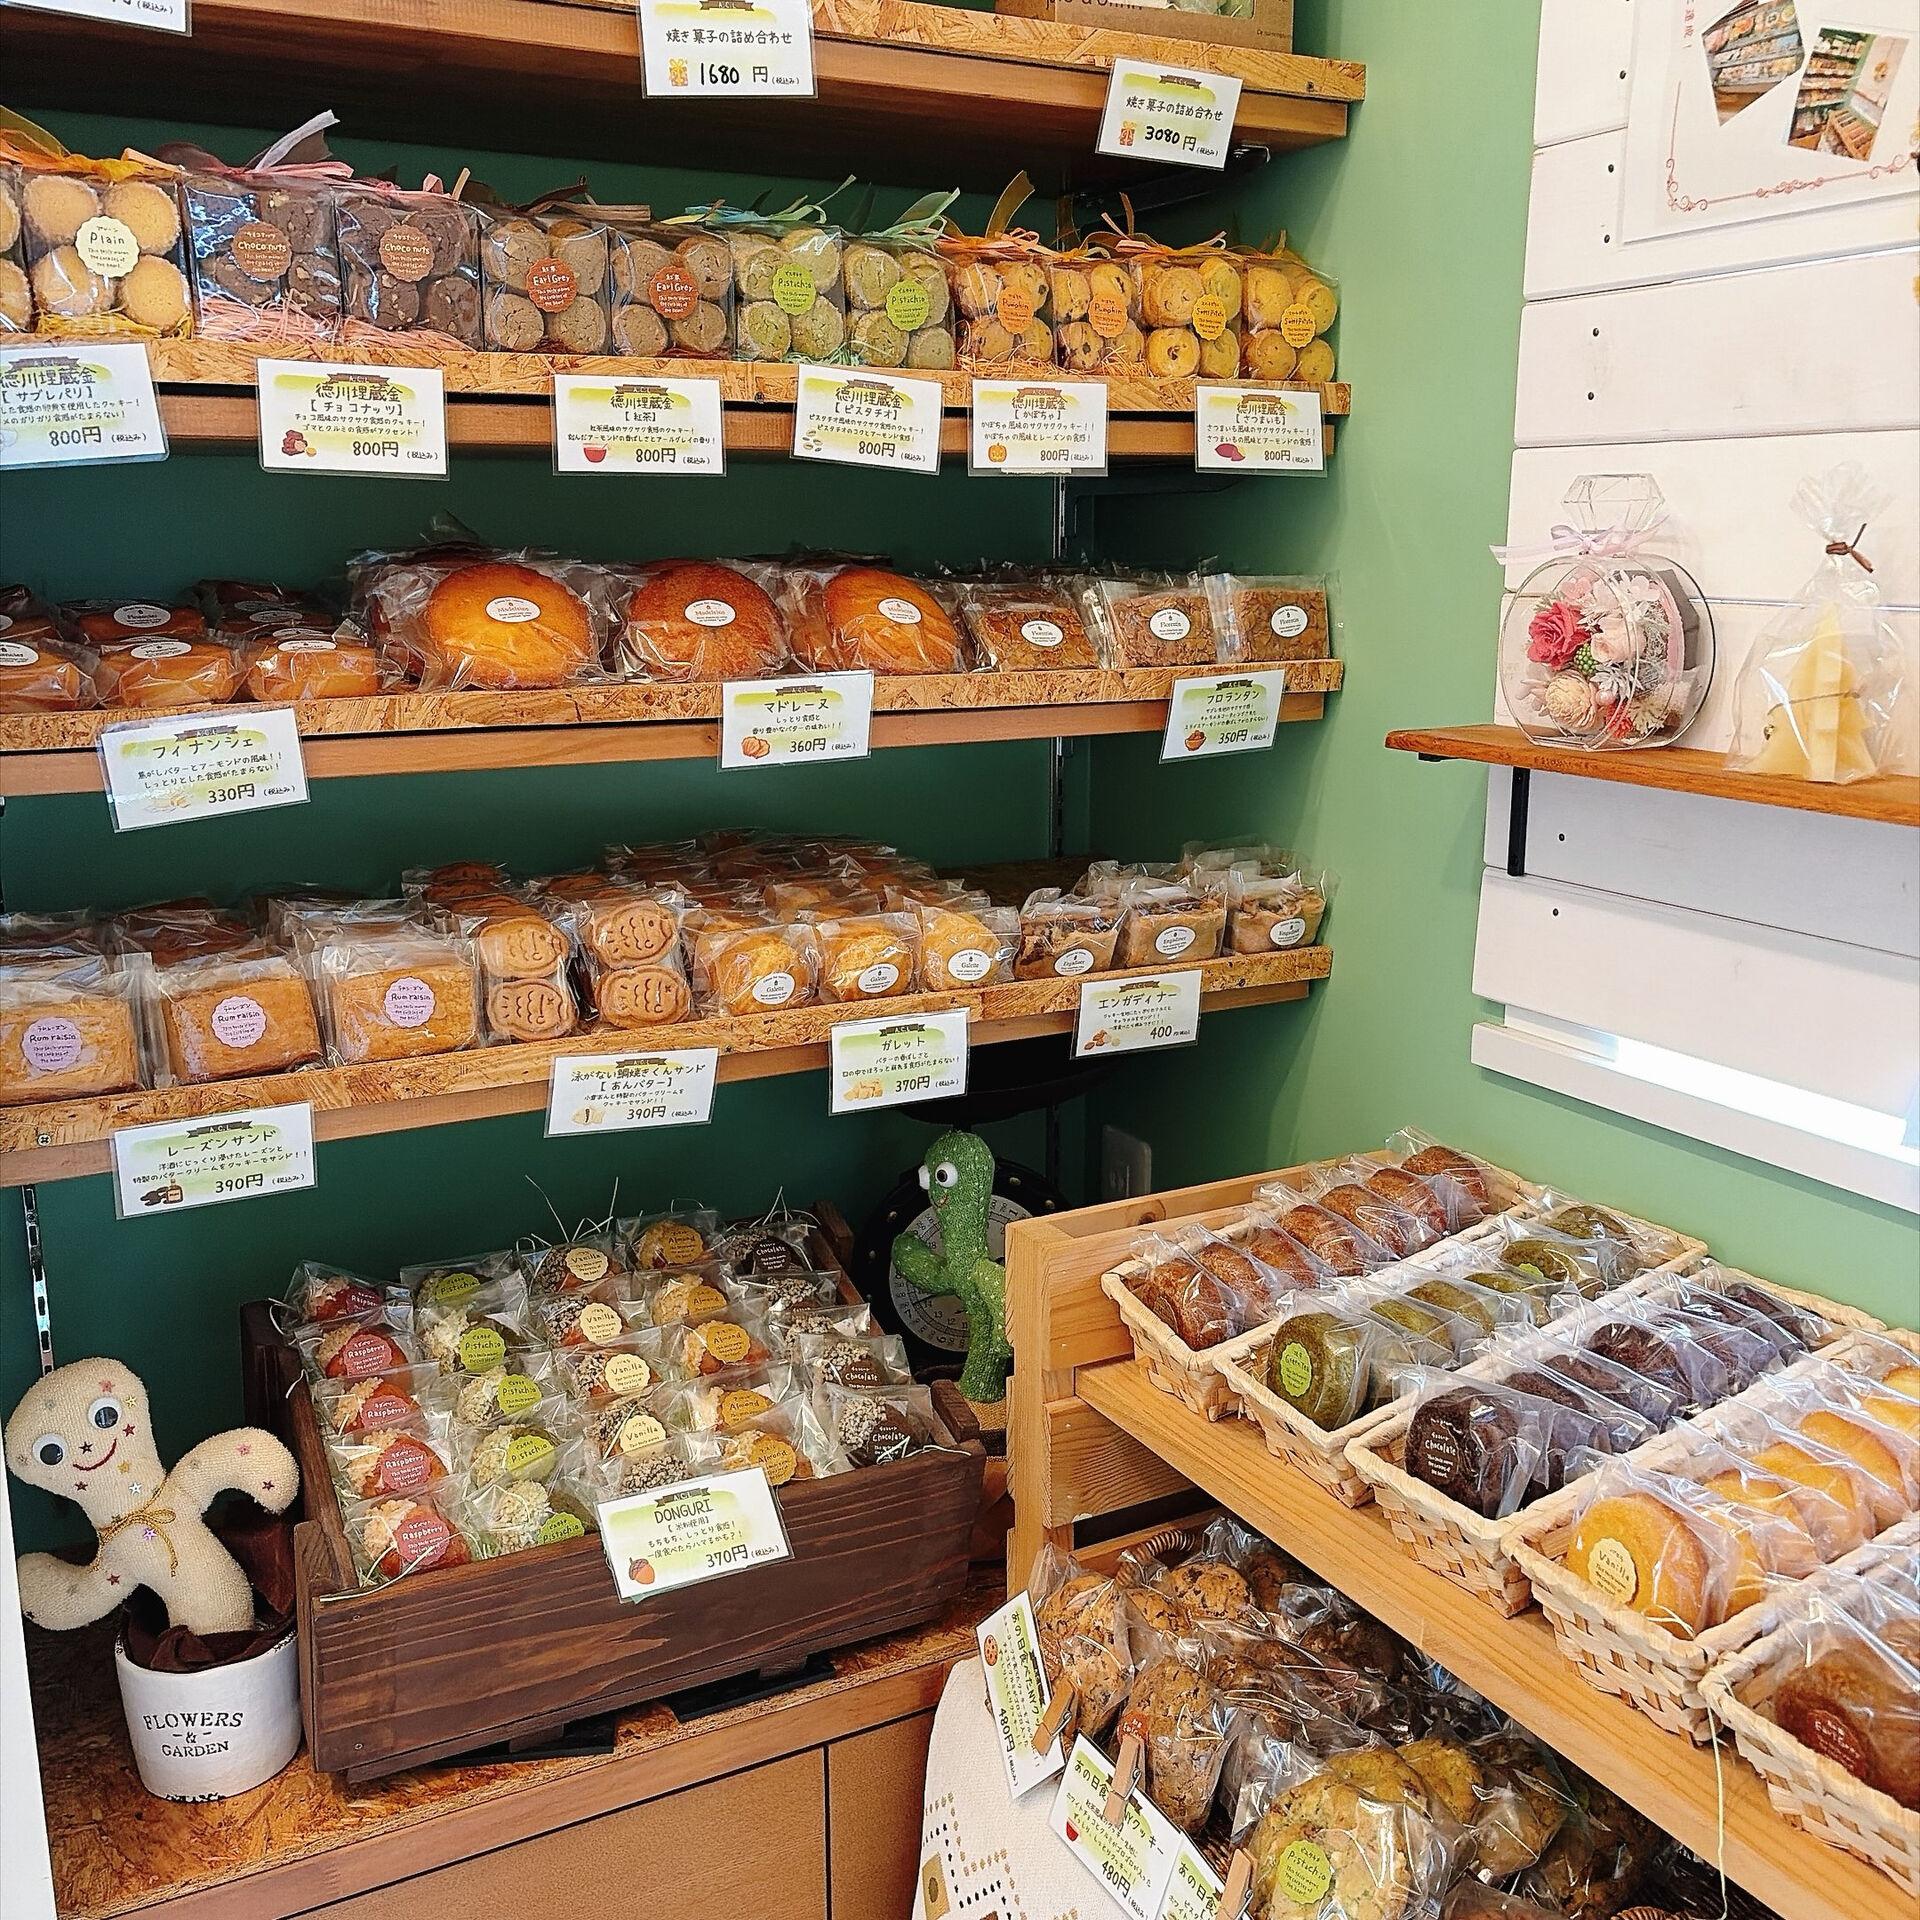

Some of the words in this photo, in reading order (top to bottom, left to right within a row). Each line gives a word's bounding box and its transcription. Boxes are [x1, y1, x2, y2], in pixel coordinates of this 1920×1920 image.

[666, 28, 793, 44] 焼き菓子の詰め合わせ
[700, 62, 740, 86] 1680
[752, 65, 768, 83] 円
[1126, 95, 1224, 121] 焼き菓子の詰め合わせ
[1145, 126, 1180, 144] 3080
[1183, 136, 1197, 152] 円
[91, 232, 124, 244] Plain
[268, 243, 287, 252] nuts
[412, 246, 430, 254] nuts
[533, 275, 550, 286] Earl
[551, 274, 570, 284] Grey
[656, 283, 673, 292] Earl
[675, 283, 693, 292] Grey
[316, 384, 403, 402] 徳川埋蔵金
[835, 387, 904, 410] 徳川埋蔵金
[610, 396, 674, 410] 徳川埋蔵金
[49, 426, 101, 447] 800円
[352, 441, 399, 458] 800円
[635, 447, 676, 463] 800円
[858, 441, 896, 458] 800円
[1040, 449, 1069, 461] 800円
[1264, 449, 1291, 461] 800円
[1207, 690, 1260, 705] フロランタン
[764, 698, 830, 713] マドレーヌ
[1218, 729, 1249, 744] 350円
[153, 736, 254, 759] フィナンシェ
[789, 737, 827, 753] 360円
[207, 783, 255, 804] 330円
[391, 993, 410, 1002] Rum
[411, 993, 431, 1002] raisin
[1098, 991, 1177, 1010] エンガディナー
[217, 1013, 239, 1024] Rum
[239, 1009, 261, 1019] raisin
[29, 1034, 50, 1044] Rum
[51, 1032, 77, 1042] raisin
[1150, 1025, 1172, 1039] 400
[882, 1036, 925, 1051] ガレット
[895, 1075, 931, 1093] 370円
[626, 1105, 667, 1120] 390円
[167, 1130, 276, 1157] レーズンサンド
[215, 1173, 263, 1193] 390円
[668, 1236, 695, 1244] Almond
[571, 1254, 601, 1264] Vanilla
[586, 1314, 615, 1324] Vanilla
[713, 1333, 742, 1344] Almond
[347, 1344, 385, 1359] Raspberry
[611, 1364, 643, 1376] Vanilla
[367, 1407, 406, 1419] Raspberry
[729, 1401, 760, 1411] Almond
[626, 1427, 659, 1441] Vanilla
[1425, 1439, 1456, 1456] Chocolate
[385, 1455, 424, 1469] Raspberry
[758, 1450, 788, 1464] Almond
[654, 1498, 714, 1524] DONGURI
[402, 1526, 443, 1541] Raspberry
[706, 1544, 748, 1568] 370円
[1600, 1550, 1630, 1580] Vanilla
[143, 1712, 244, 1730] FLOWERS
[998, 1707, 1016, 1753] 480円
[162, 1740, 229, 1758] GARDEN
[1101, 1861, 1131, 1899] 480円
